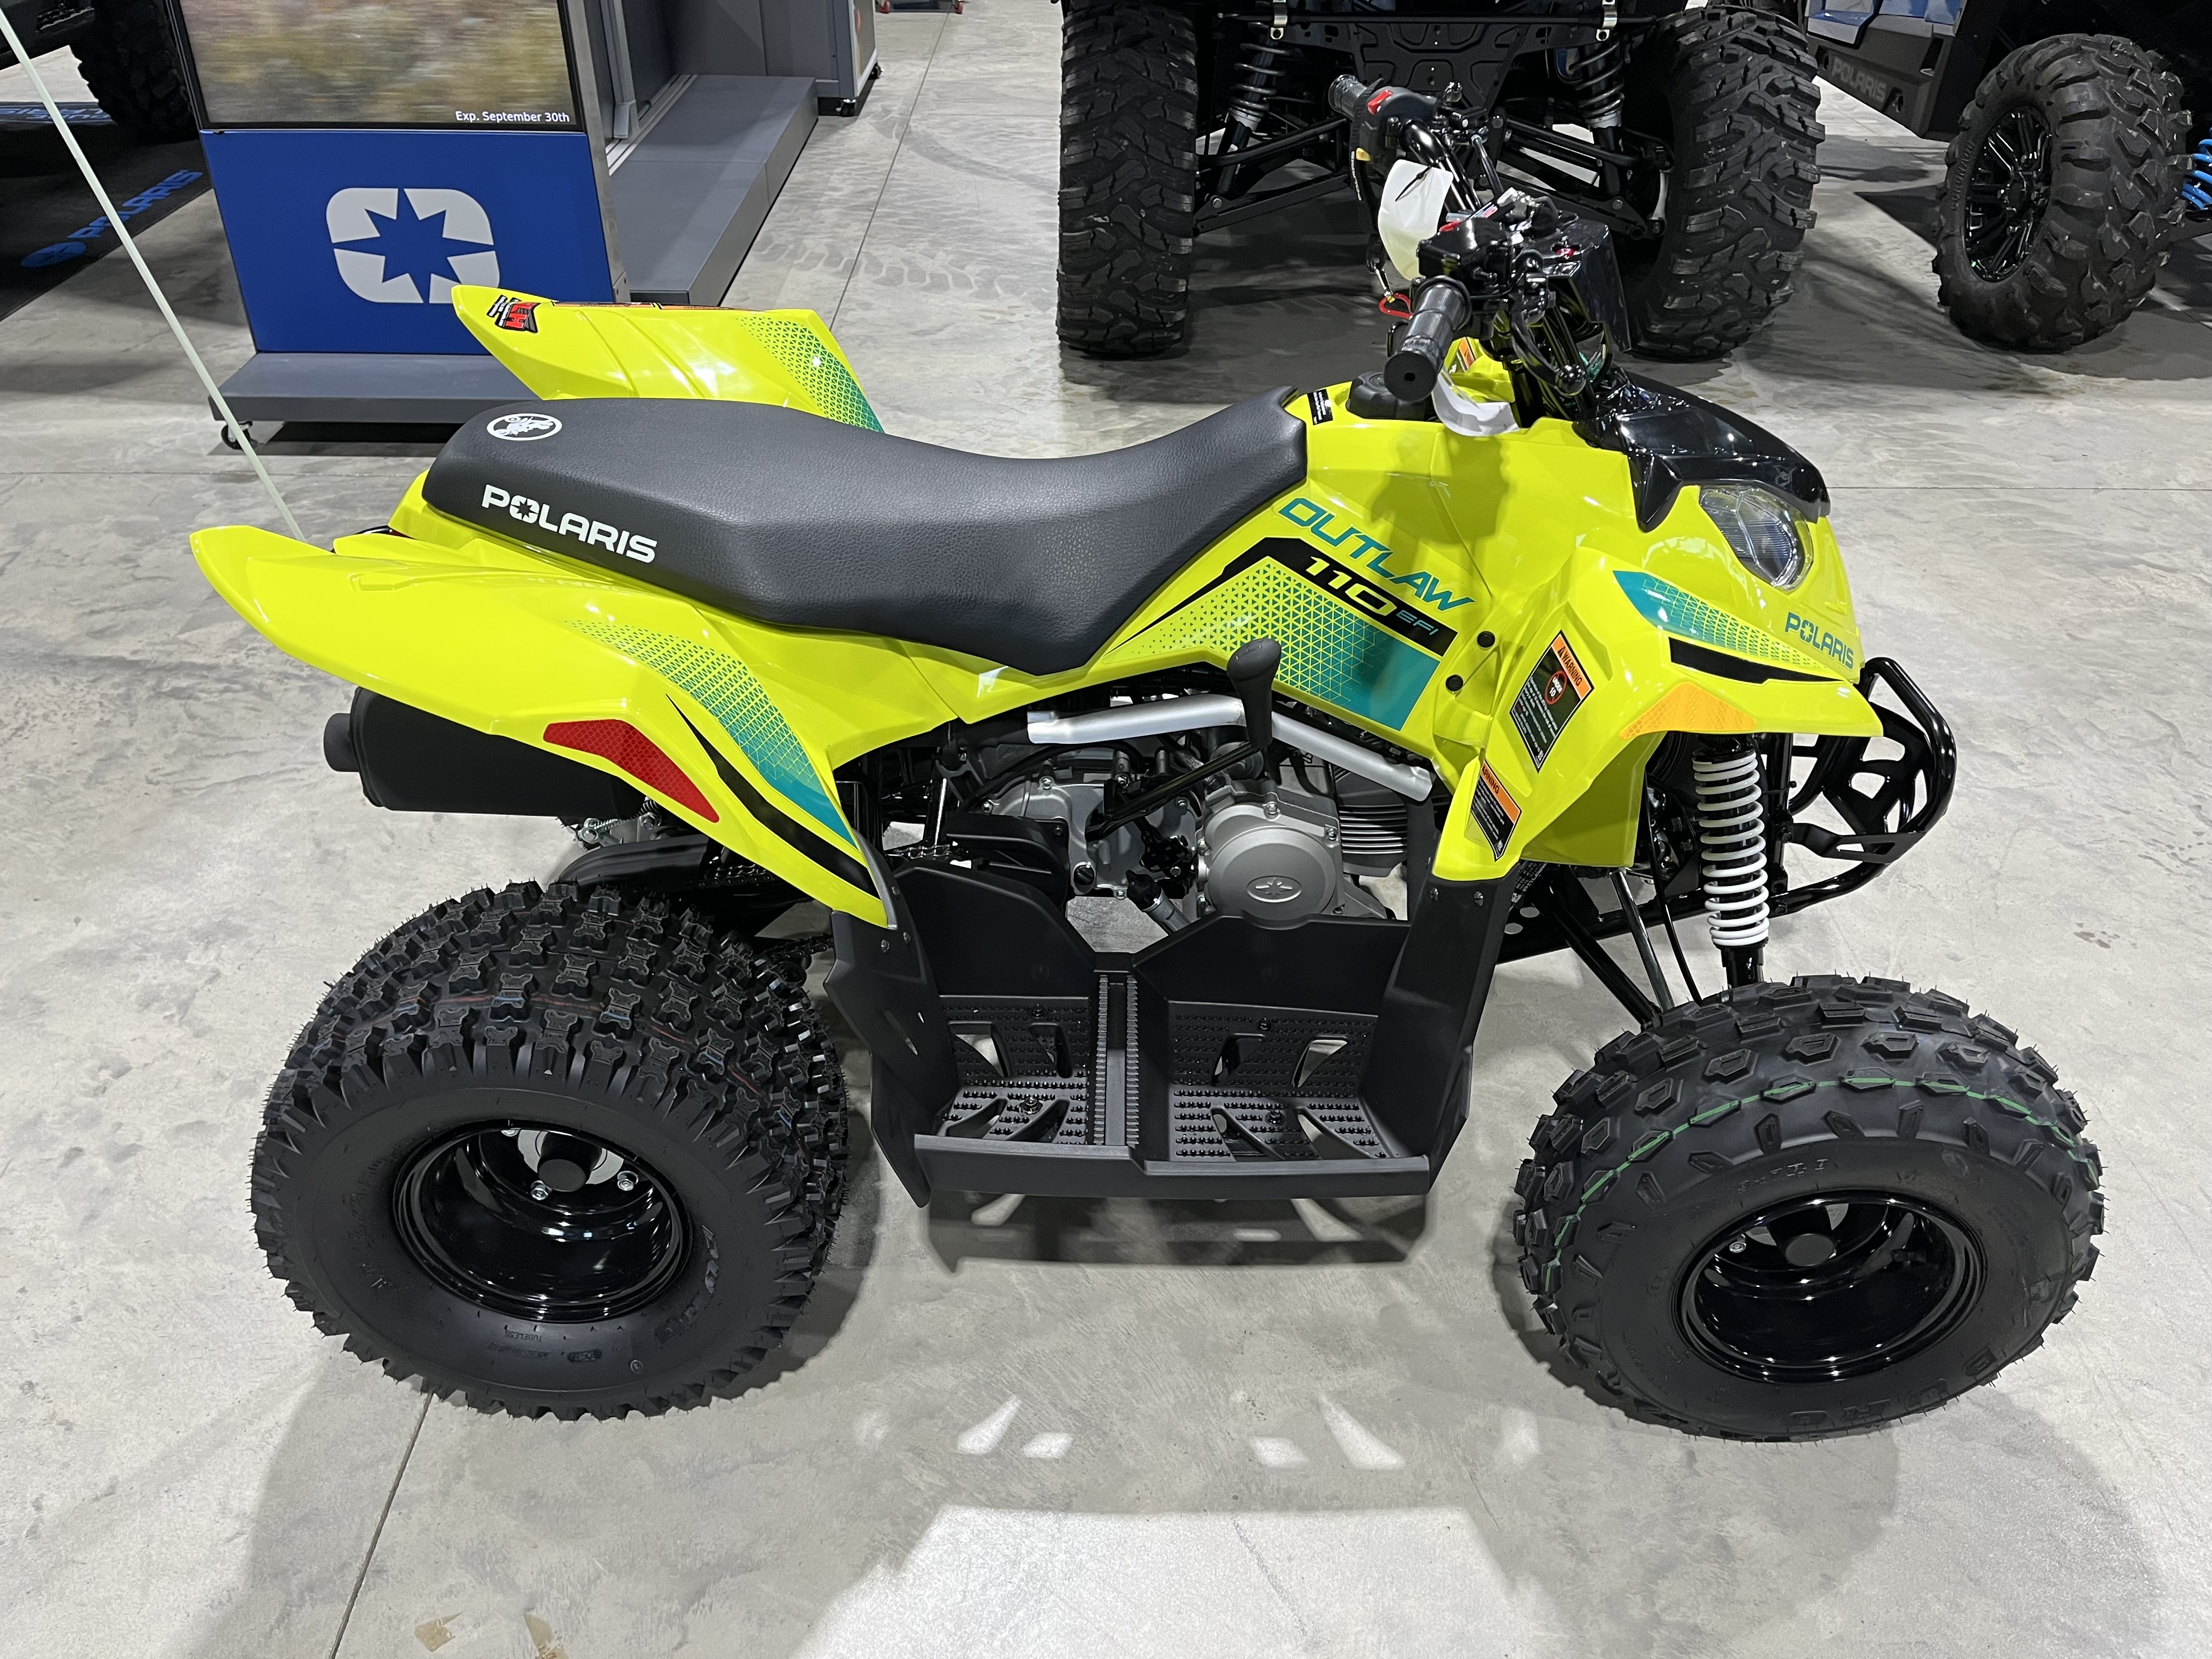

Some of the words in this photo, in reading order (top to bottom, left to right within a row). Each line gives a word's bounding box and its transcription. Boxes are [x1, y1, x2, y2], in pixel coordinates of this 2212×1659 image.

[1832, 57, 1887, 103] POLARIS
[455, 111, 479, 122] Exp.
[482, 112, 542, 123] September
[545, 112, 570, 122] 30th
[482, 484, 657, 563] POLARIS
[1278, 498, 1476, 612] OUTLAW
[1306, 556, 1397, 617] 110
[1396, 610, 1438, 636] EFI
[1785, 612, 1854, 669] POLARIS
[1562, 651, 1582, 686] WARNING
[1482, 765, 1499, 794] ARNING
